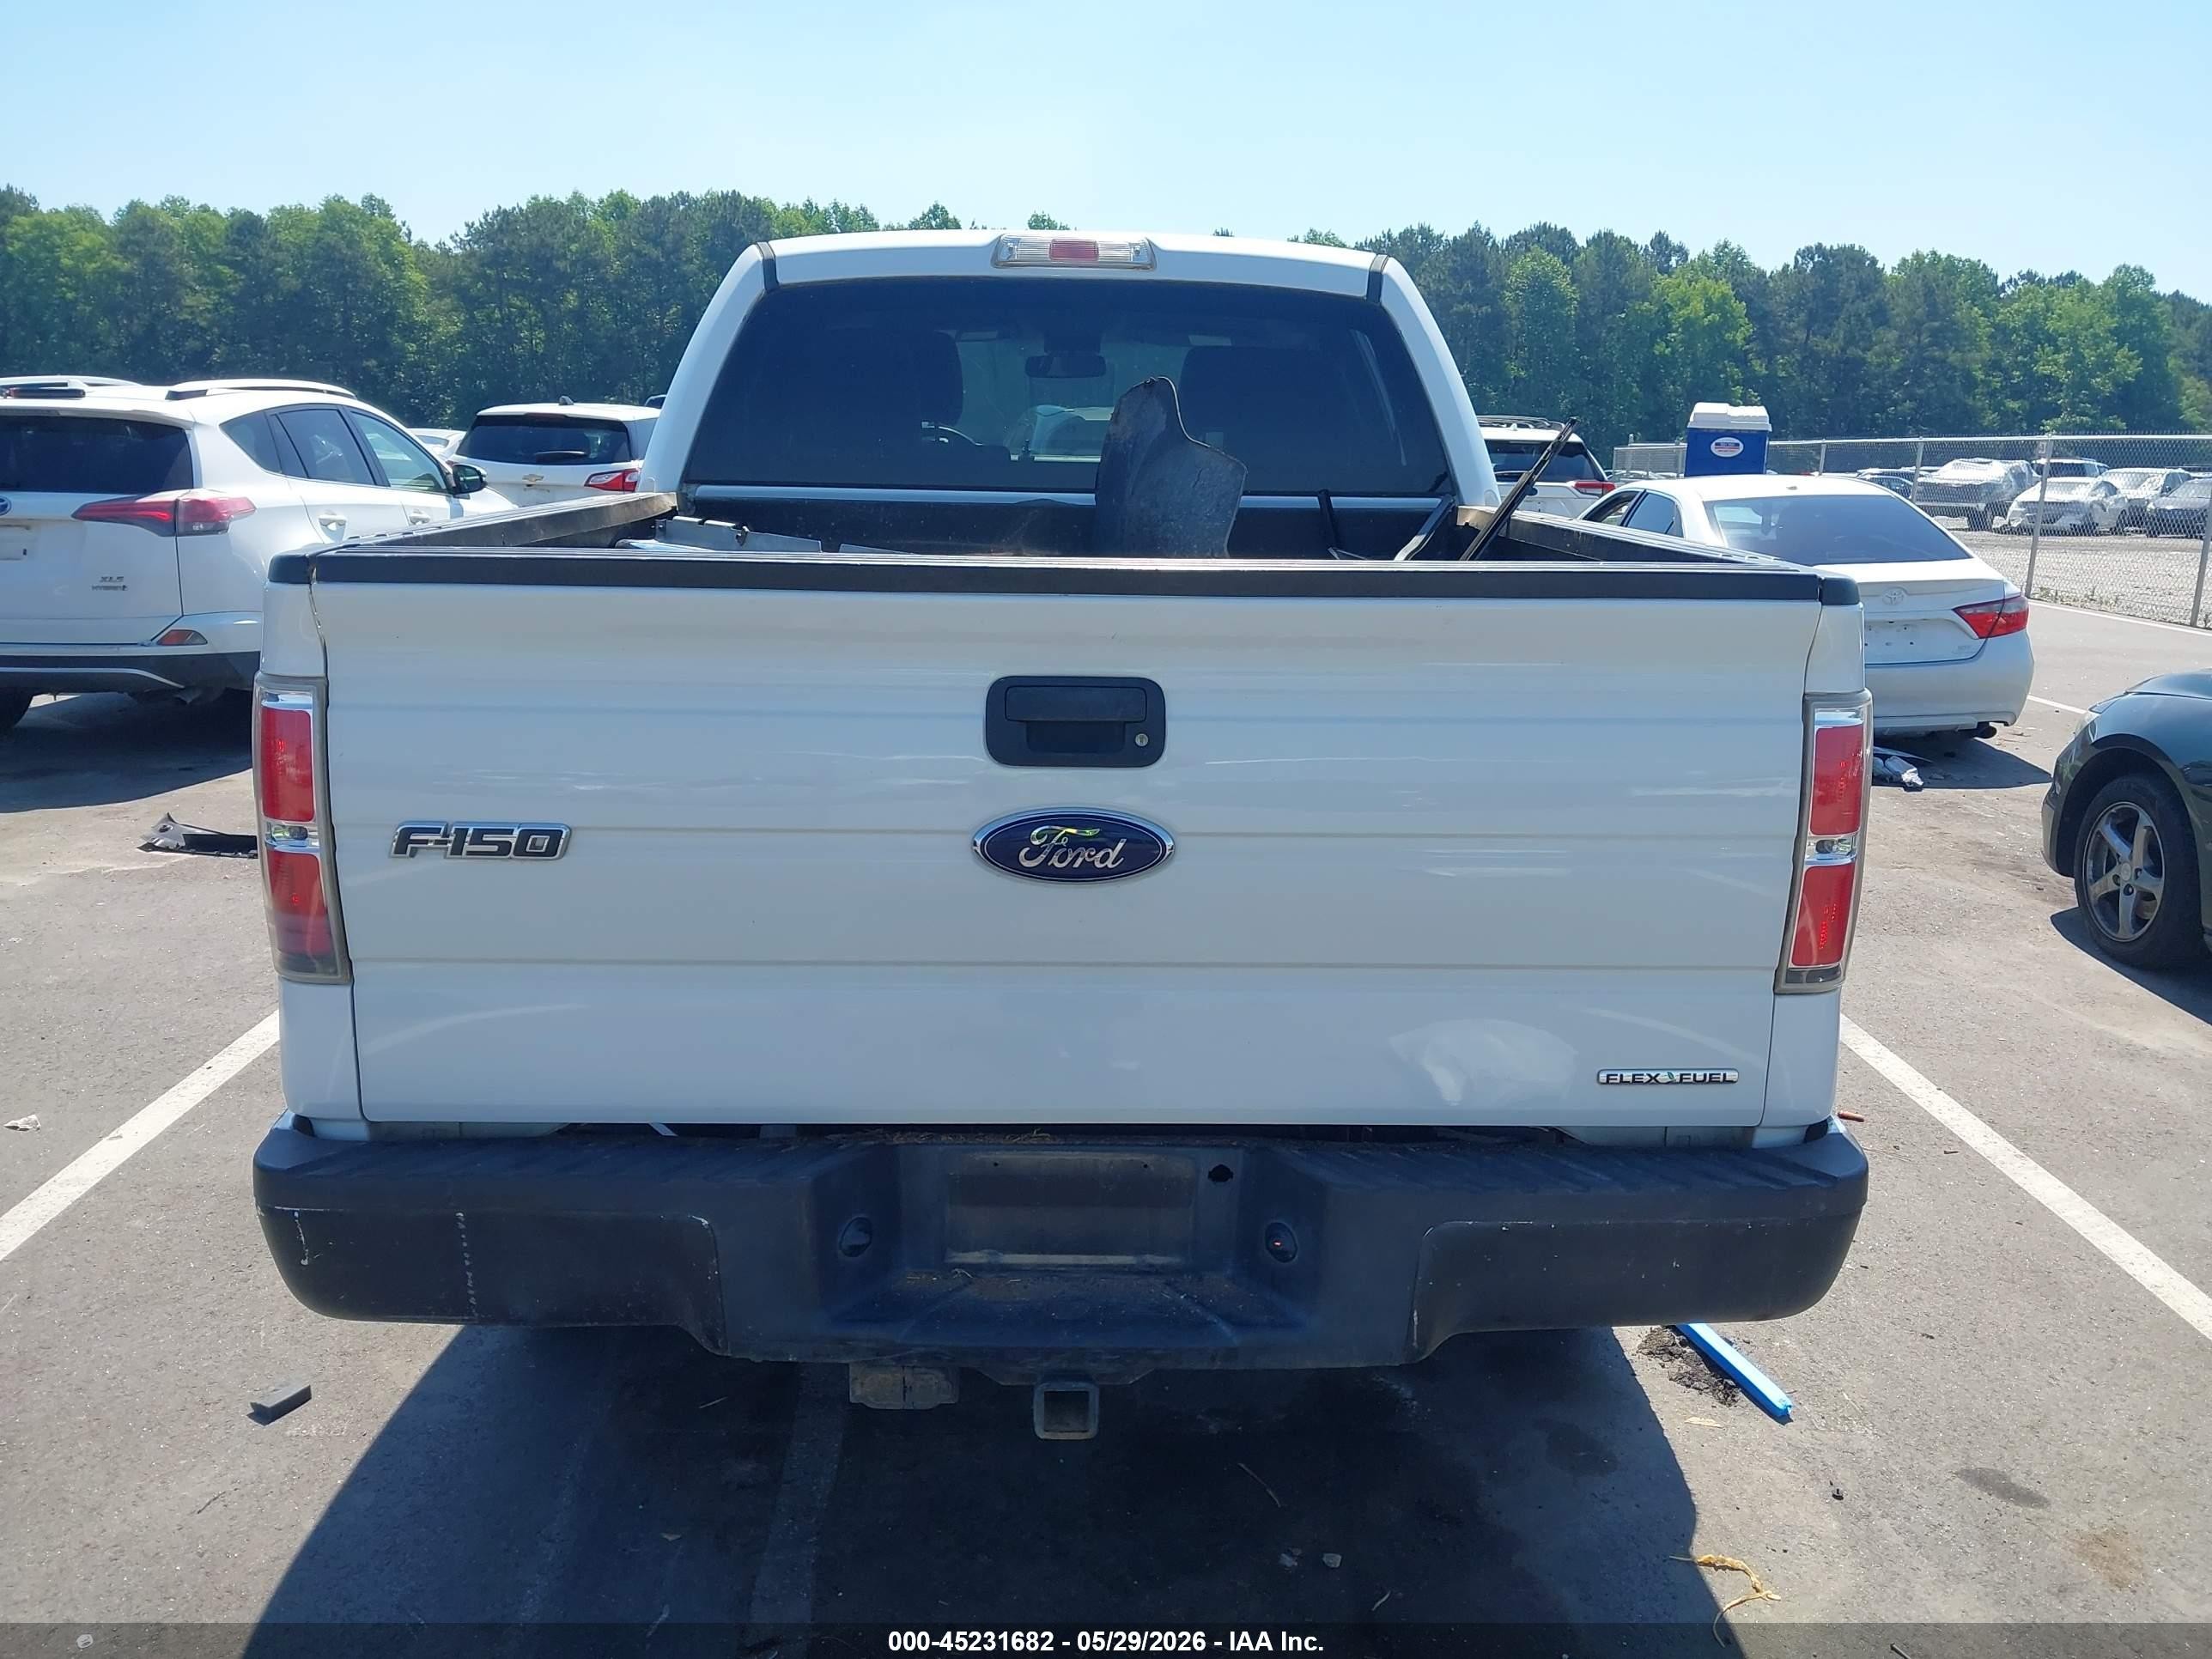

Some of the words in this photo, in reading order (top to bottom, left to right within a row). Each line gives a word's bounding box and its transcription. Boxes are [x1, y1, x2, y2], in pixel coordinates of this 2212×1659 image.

[391, 821, 571, 860] F-150
[1018, 825, 1127, 869] Ford
[1605, 1073, 1661, 1084] FLEX
[1678, 1072, 1736, 1084] FUEL
